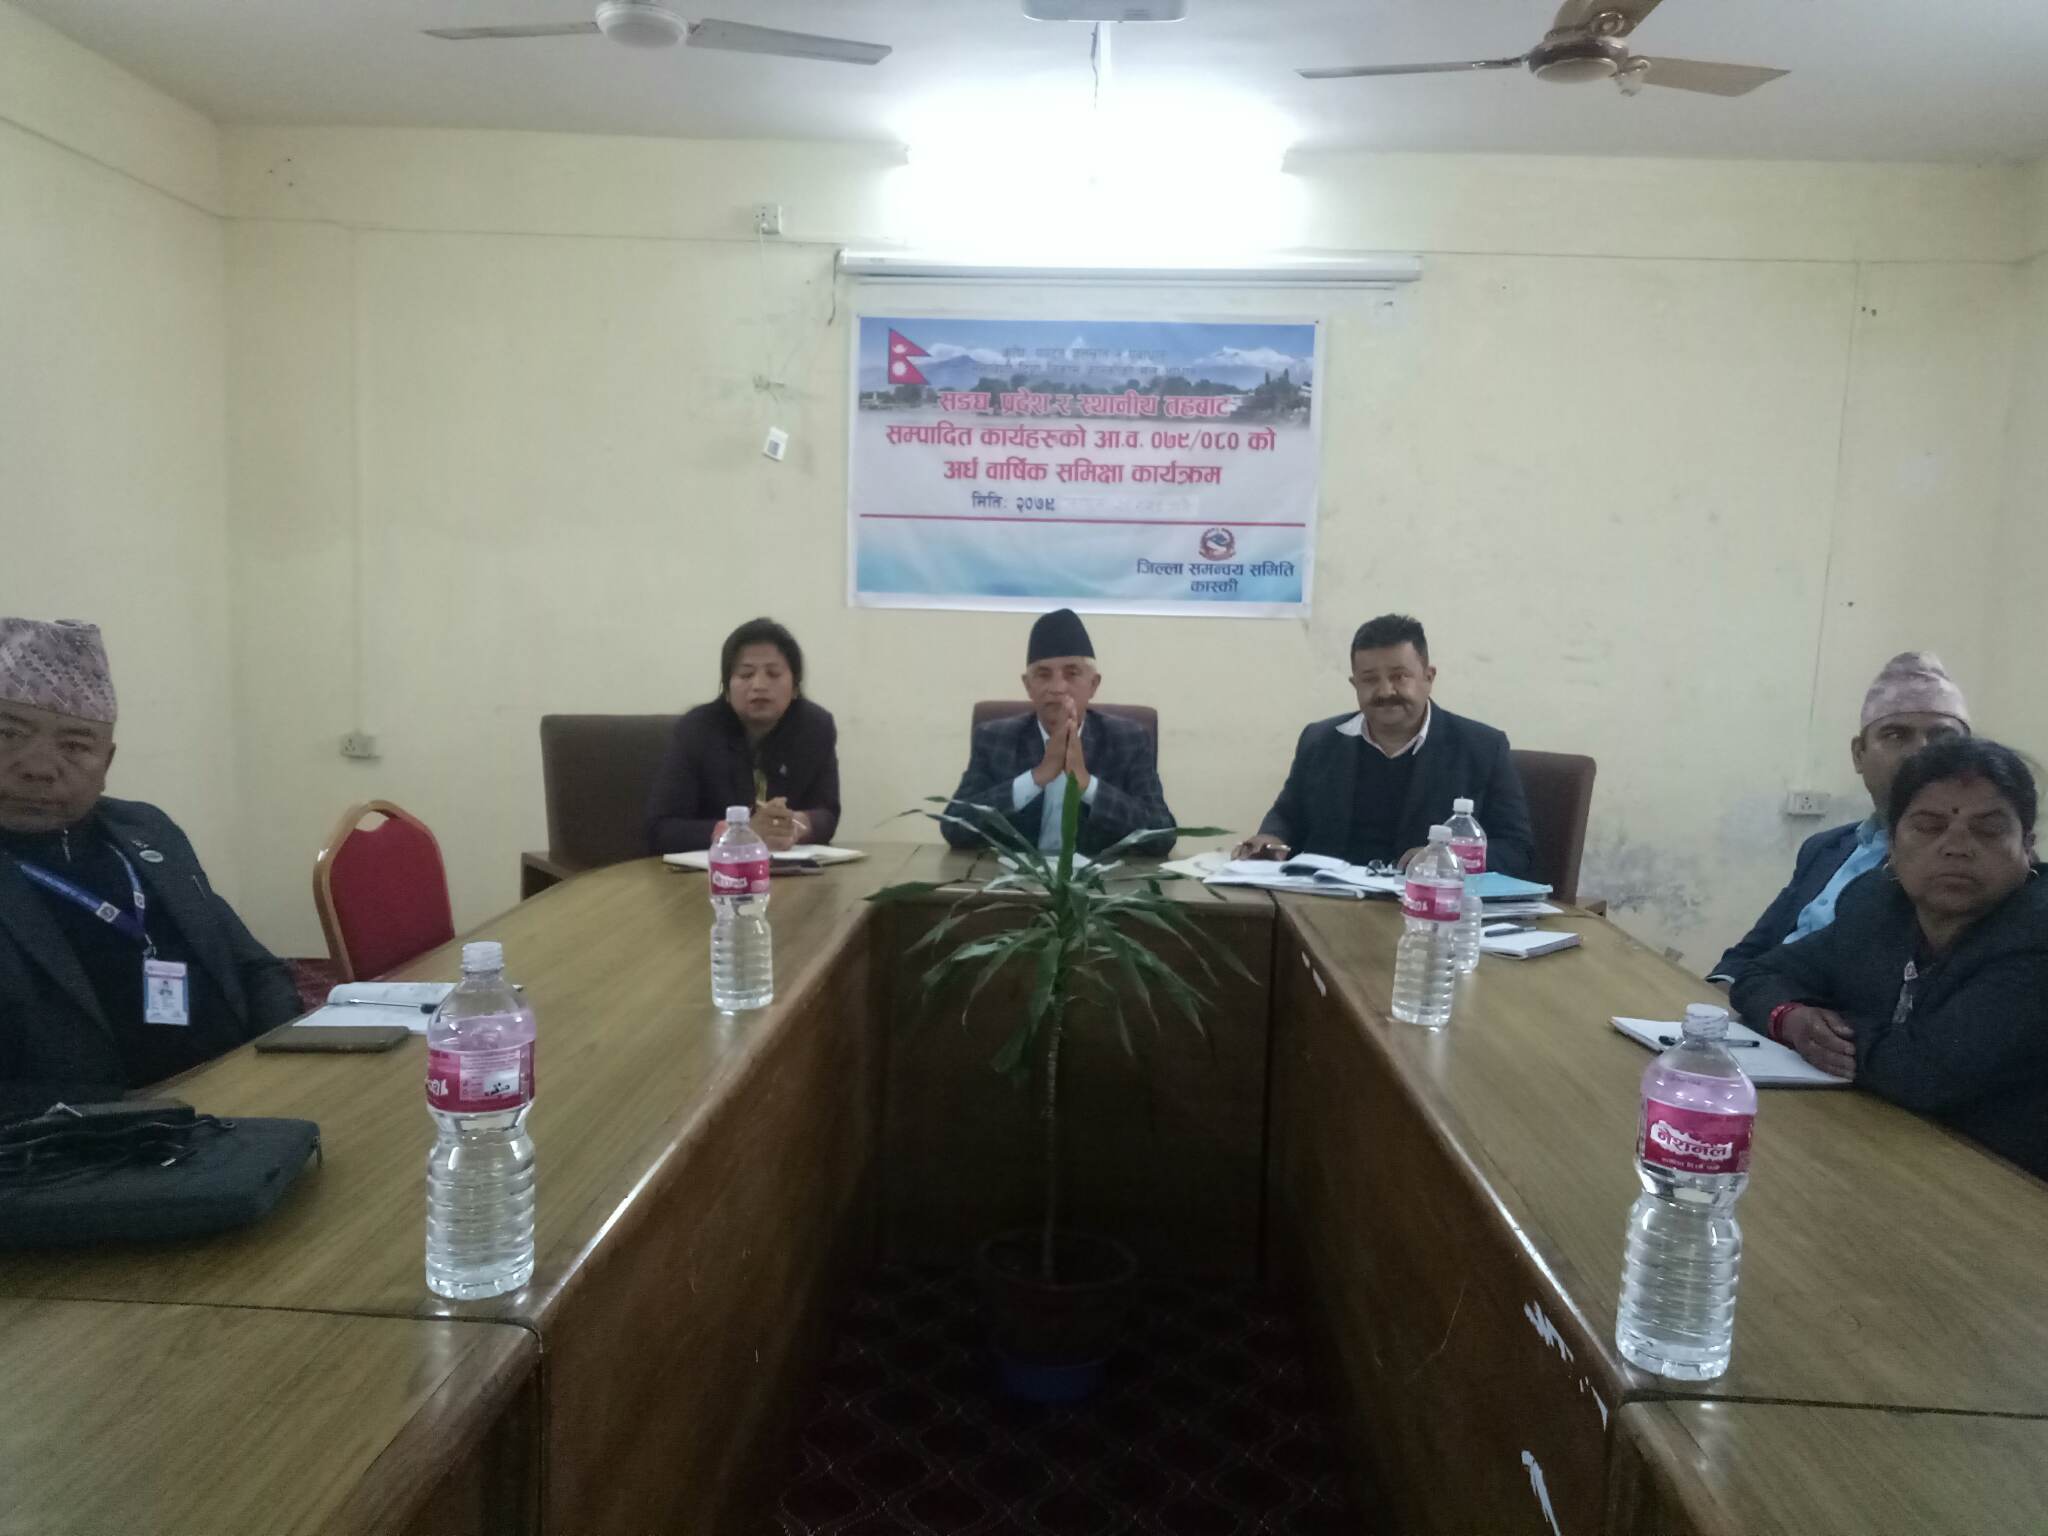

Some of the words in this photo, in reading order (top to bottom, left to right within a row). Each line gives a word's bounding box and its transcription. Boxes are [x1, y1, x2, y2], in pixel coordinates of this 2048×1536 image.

[1055, 393, 1073, 415] र
[1079, 390, 1157, 416] स्थानीय
[1164, 395, 1231, 416] तहबाट
[886, 420, 972, 445] सम्पादित
[1247, 426, 1278, 451] को
[985, 456, 1049, 481] वार्षिक
[1056, 457, 1124, 484] समिक्षा
[1131, 460, 1223, 485] कार्यक्रम
[1136, 558, 1184, 576] जिल्ला
[1188, 562, 1244, 577] समन्वय
[1249, 560, 1295, 578] समिति
[1190, 578, 1239, 594] कास्की
